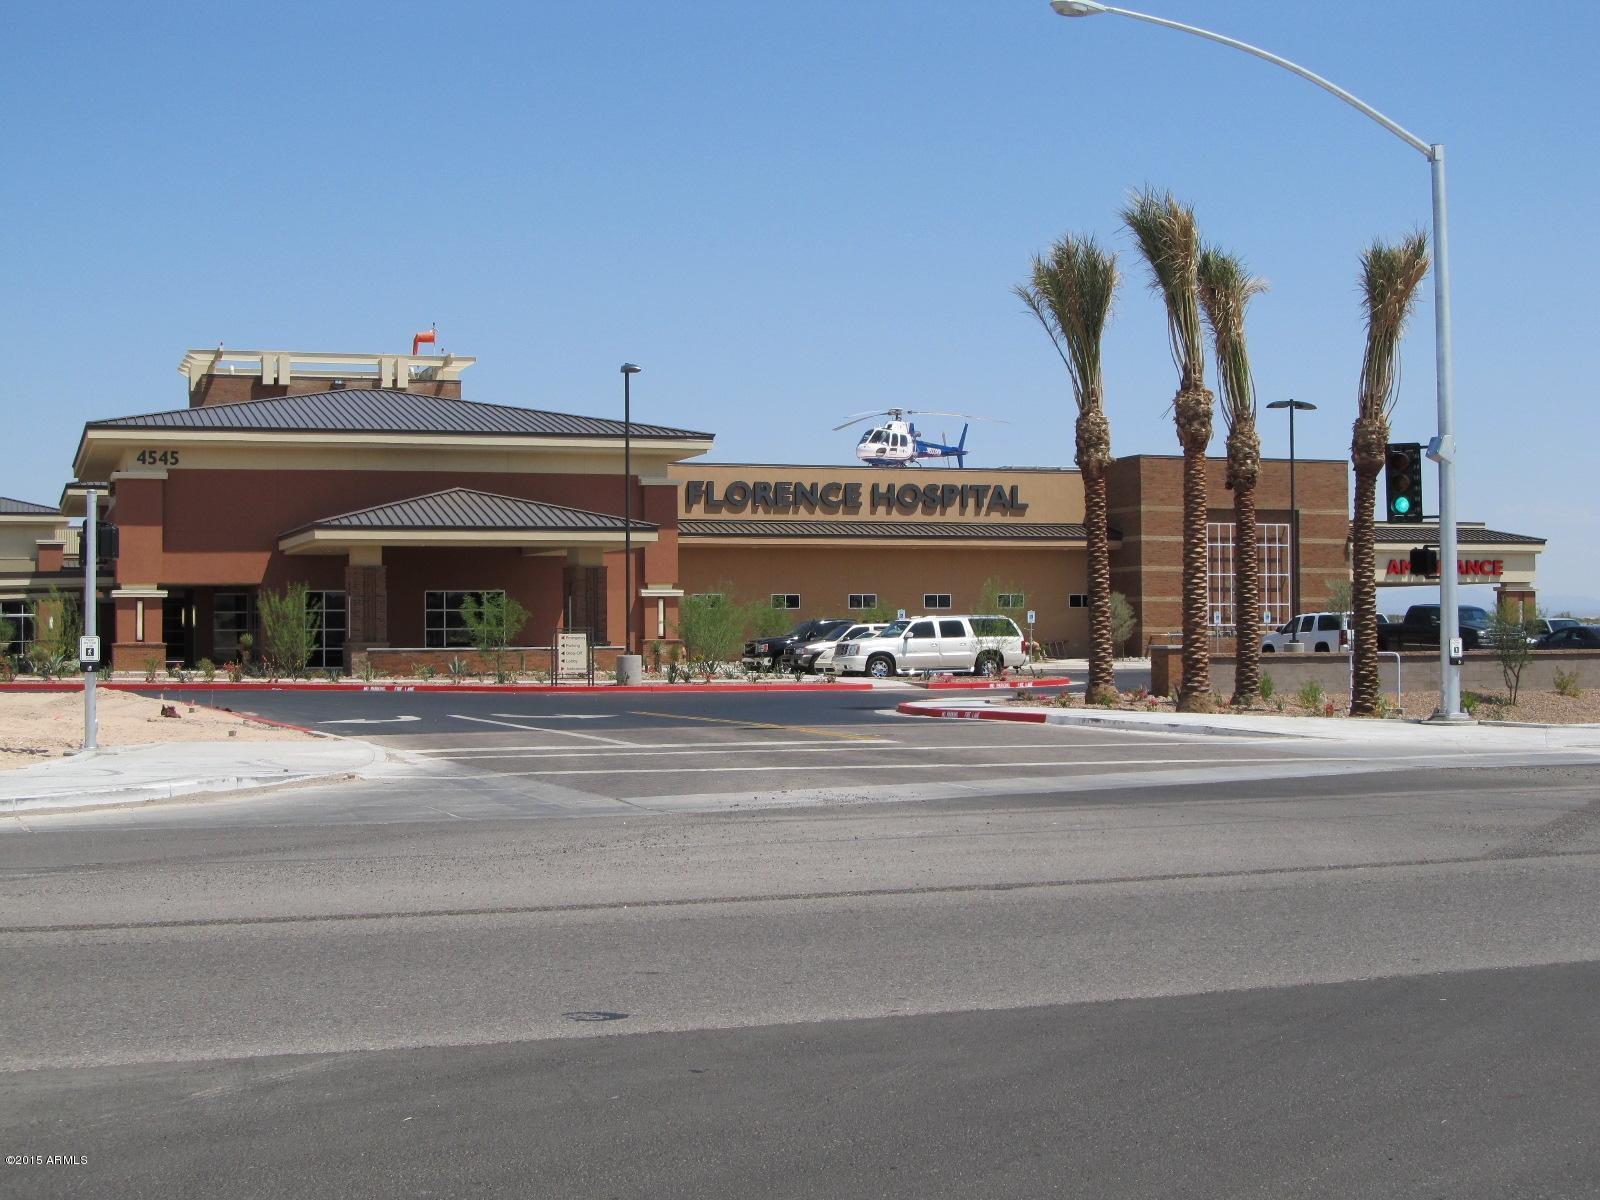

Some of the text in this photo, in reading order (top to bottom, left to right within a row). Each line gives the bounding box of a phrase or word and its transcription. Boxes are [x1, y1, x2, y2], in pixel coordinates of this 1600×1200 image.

[136, 449, 180, 466] 4545
[686, 480, 1030, 511] FLORENCE HOSPITAL
[1386, 559, 1505, 576] AMANCE
